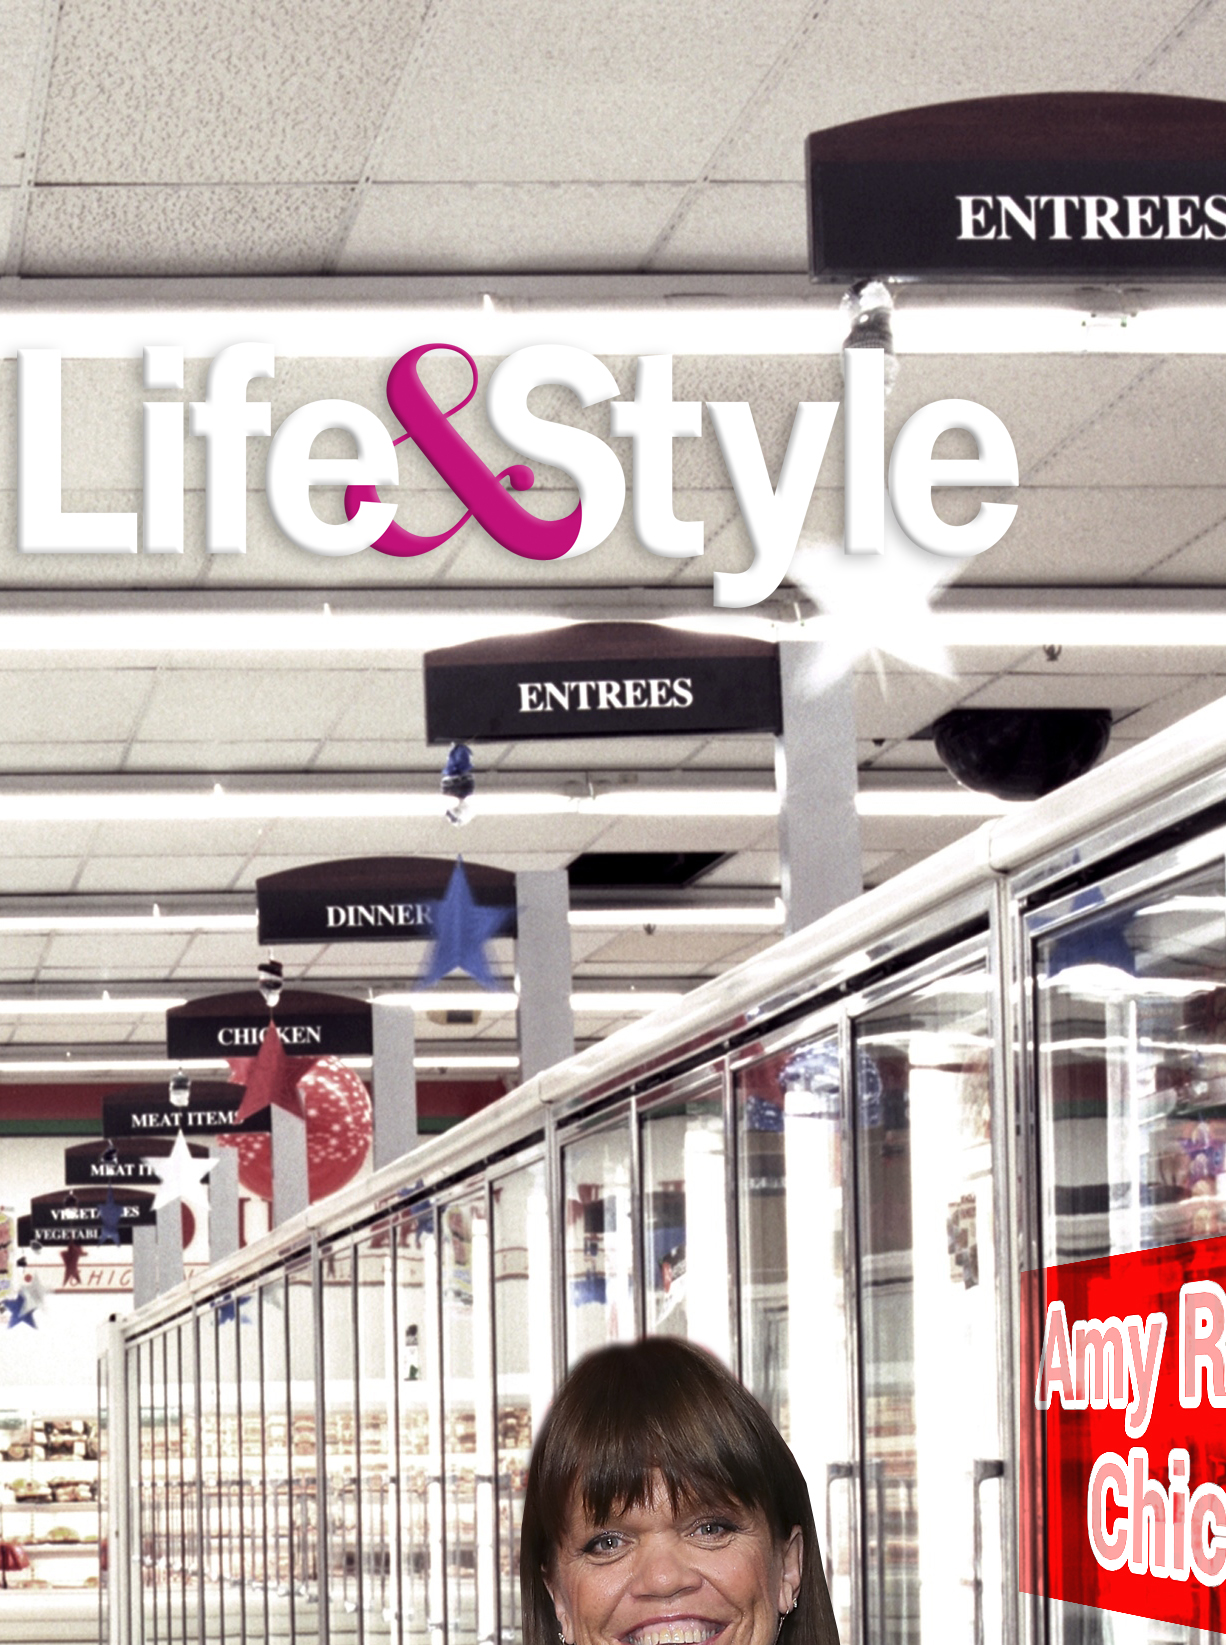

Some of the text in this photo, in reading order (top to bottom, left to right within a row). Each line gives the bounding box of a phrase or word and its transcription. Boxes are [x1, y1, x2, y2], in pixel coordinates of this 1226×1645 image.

[518, 678, 693, 712] ENTREES
[326, 903, 434, 928] DINNER
[131, 1112, 183, 1128] MEAT
